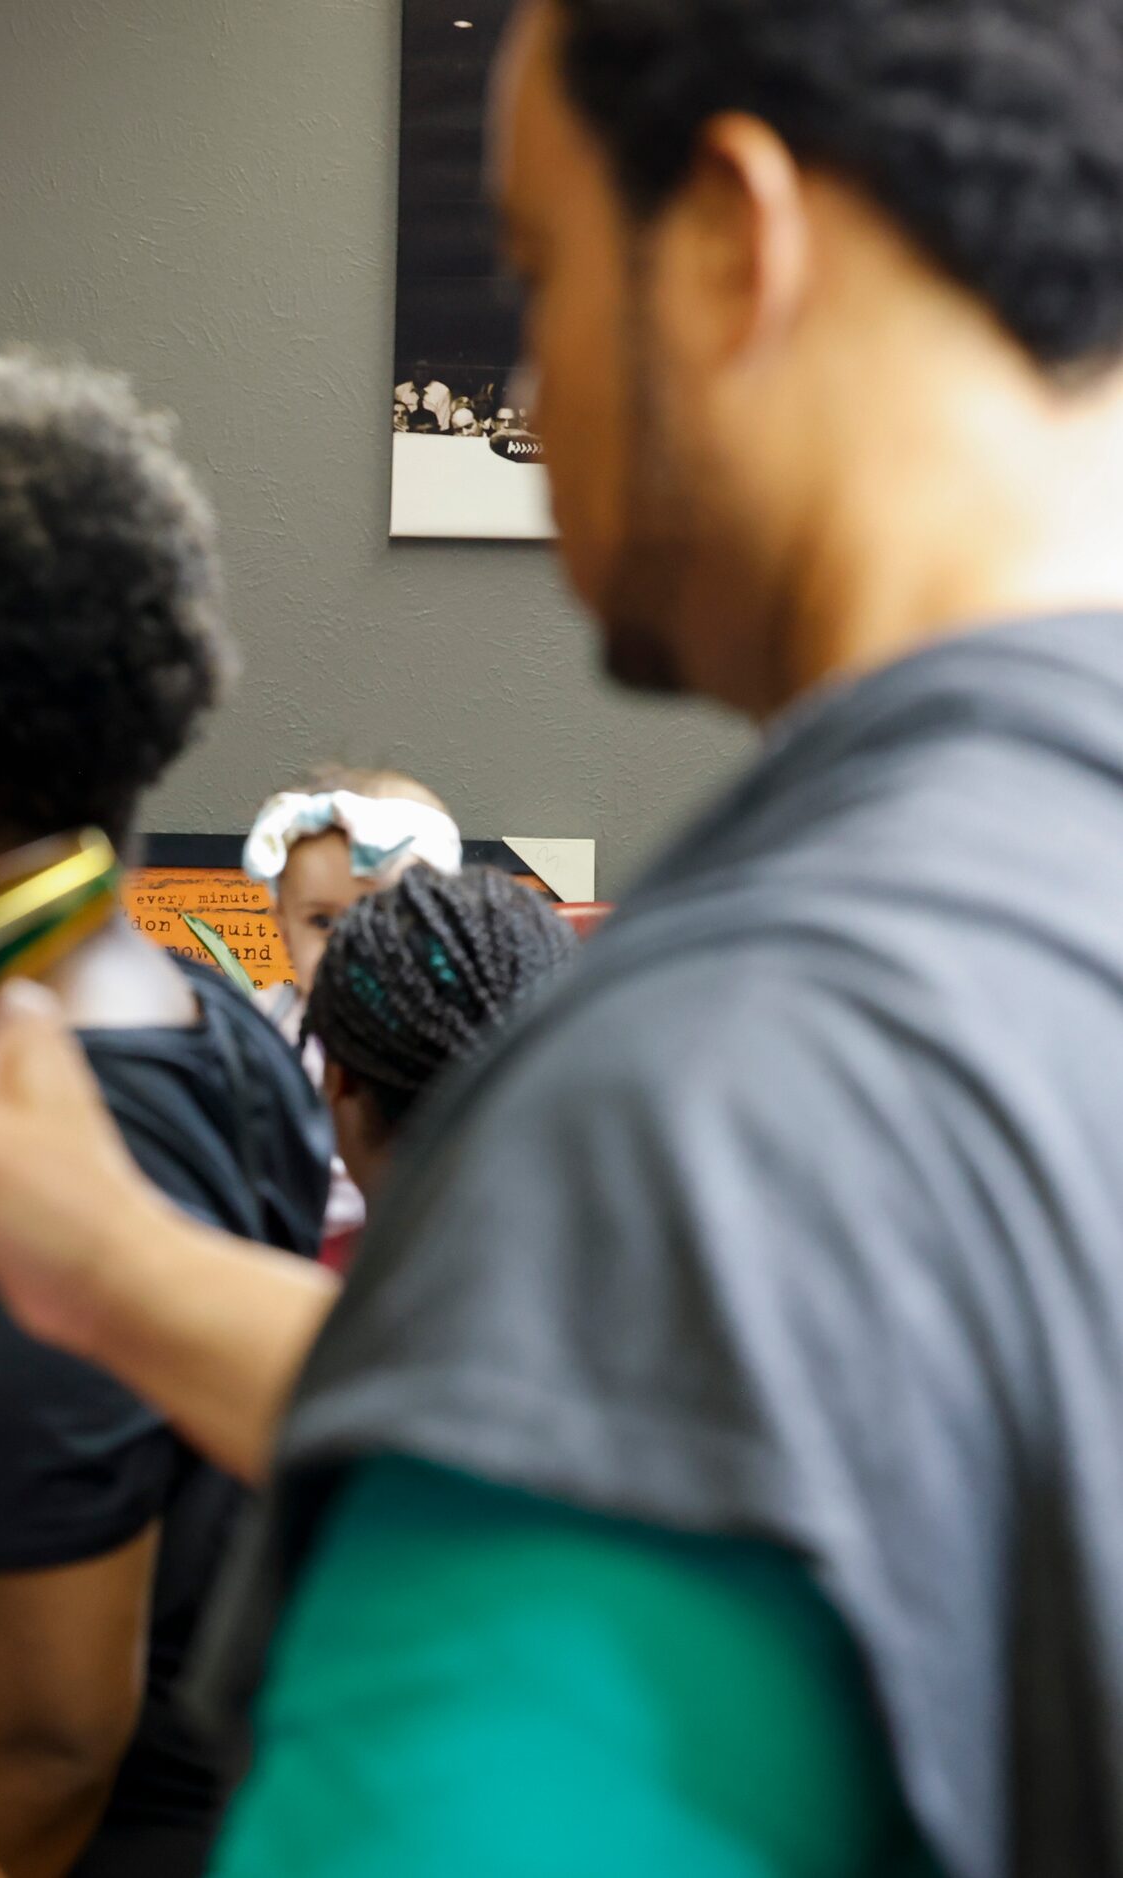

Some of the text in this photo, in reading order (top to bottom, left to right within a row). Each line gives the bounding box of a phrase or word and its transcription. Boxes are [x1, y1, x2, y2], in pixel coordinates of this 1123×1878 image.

[136, 892, 260, 907] every minute
[214, 922, 279, 938] quit.
[232, 945, 273, 961] and
